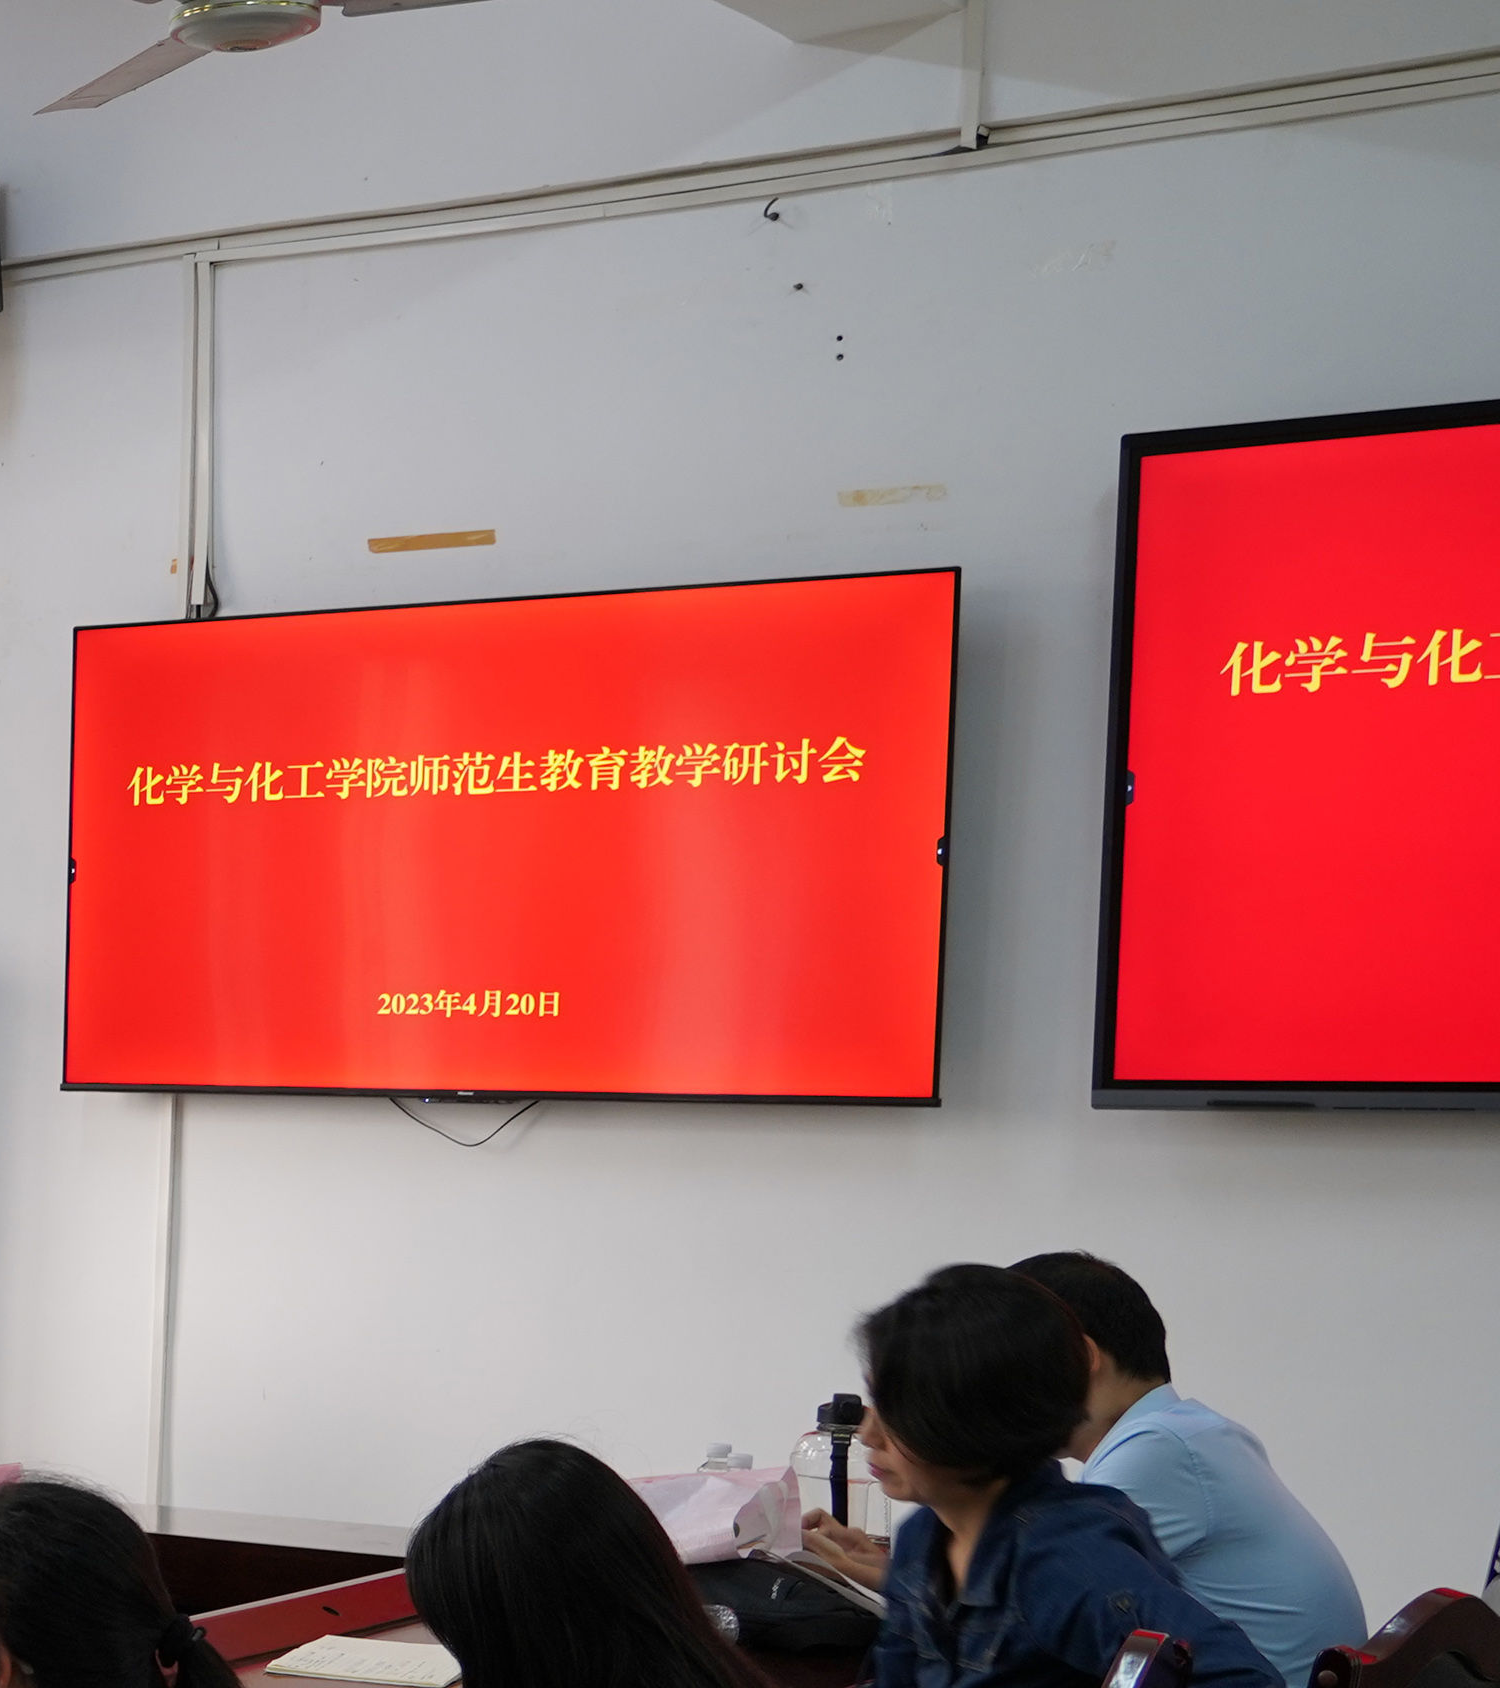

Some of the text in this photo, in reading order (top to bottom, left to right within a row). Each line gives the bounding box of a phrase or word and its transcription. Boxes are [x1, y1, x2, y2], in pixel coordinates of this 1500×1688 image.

[1219, 628, 1500, 697] 化学与化
[127, 736, 867, 807] 化学与化工学院师范生教育教学研讨会
[377, 989, 562, 1020] 2023年4月20日
